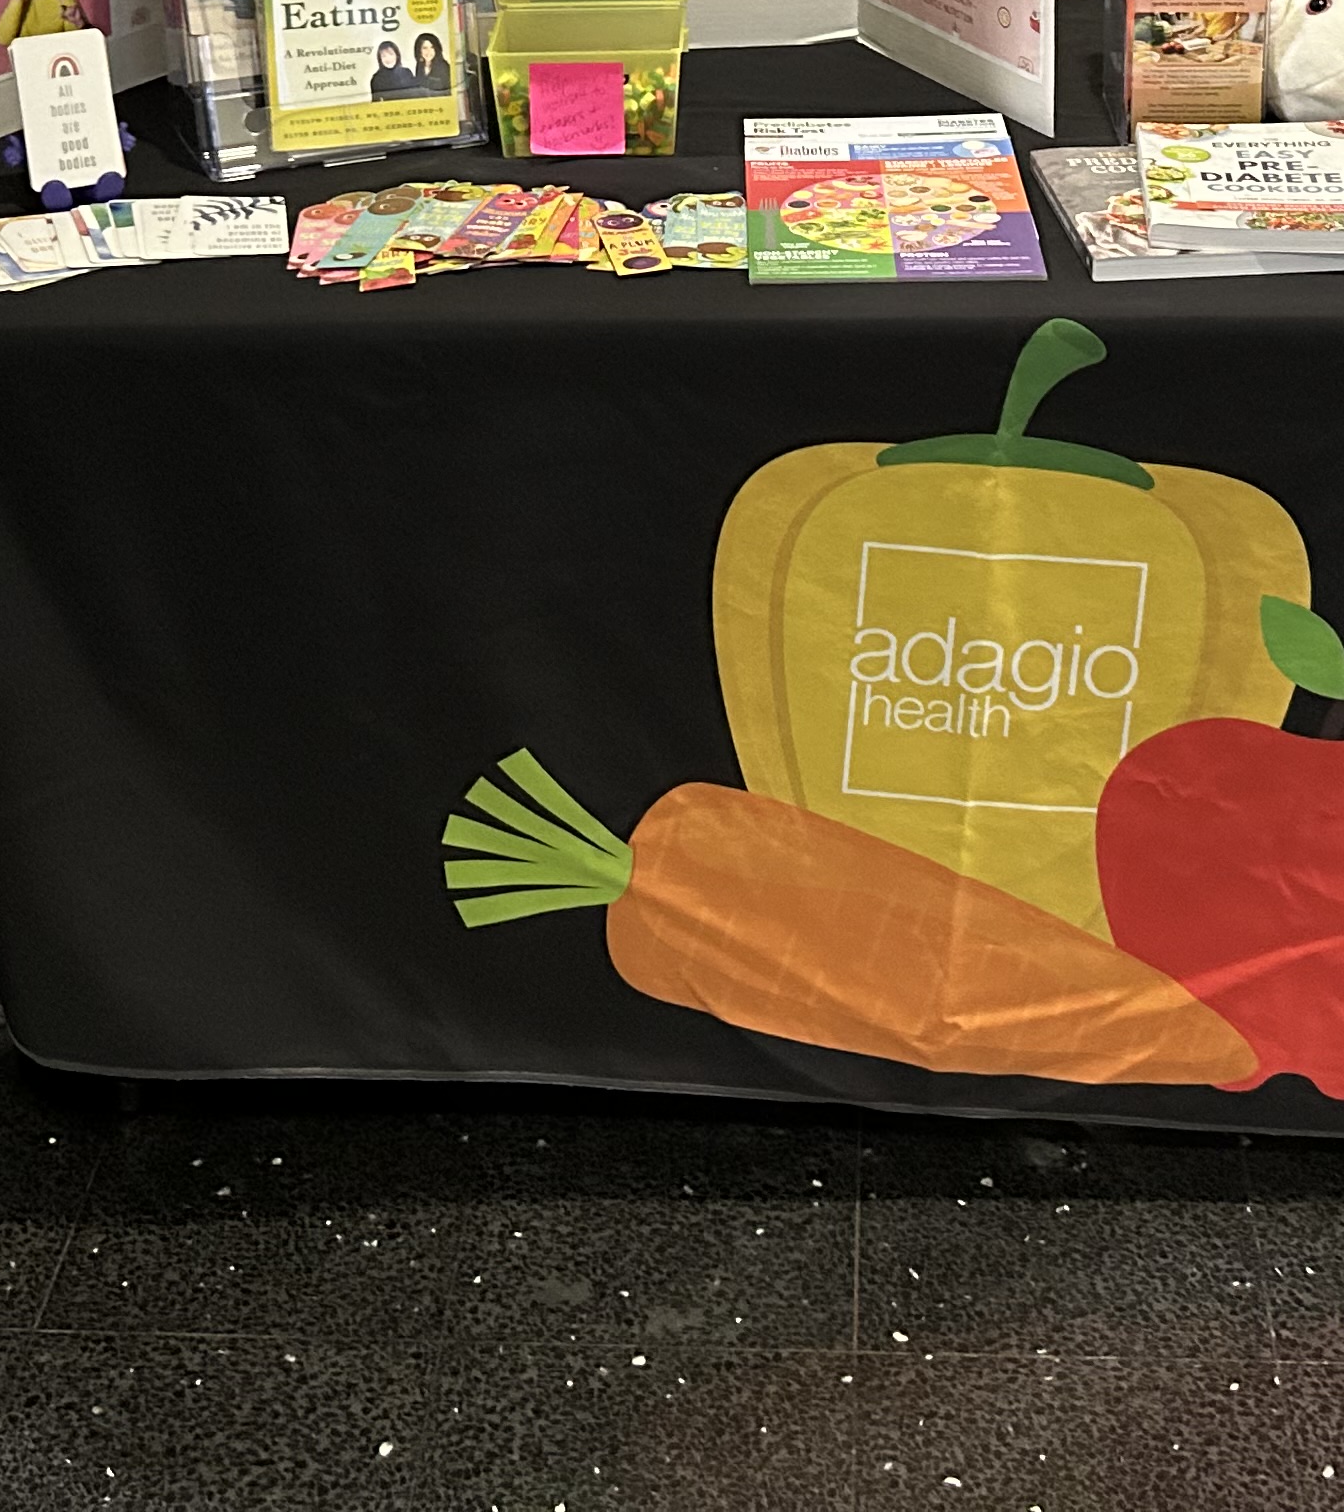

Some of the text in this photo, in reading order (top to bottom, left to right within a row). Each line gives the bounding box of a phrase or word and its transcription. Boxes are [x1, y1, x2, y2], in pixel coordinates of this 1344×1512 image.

[284, 45, 374, 59] A Revolutionary
[304, 62, 357, 74] Anti-Diet
[305, 77, 357, 91] Approach
[58, 85, 73, 98] All
[50, 101, 87, 117] bodies
[61, 120, 81, 133] are
[60, 136, 89, 154] good
[780, 146, 839, 156] Diabetes
[1236, 150, 1315, 159] EASY
[58, 155, 97, 172] bodies
[1238, 160, 1319, 171] PRE-
[849, 616, 1139, 711] adagio
[863, 683, 1011, 738] health
